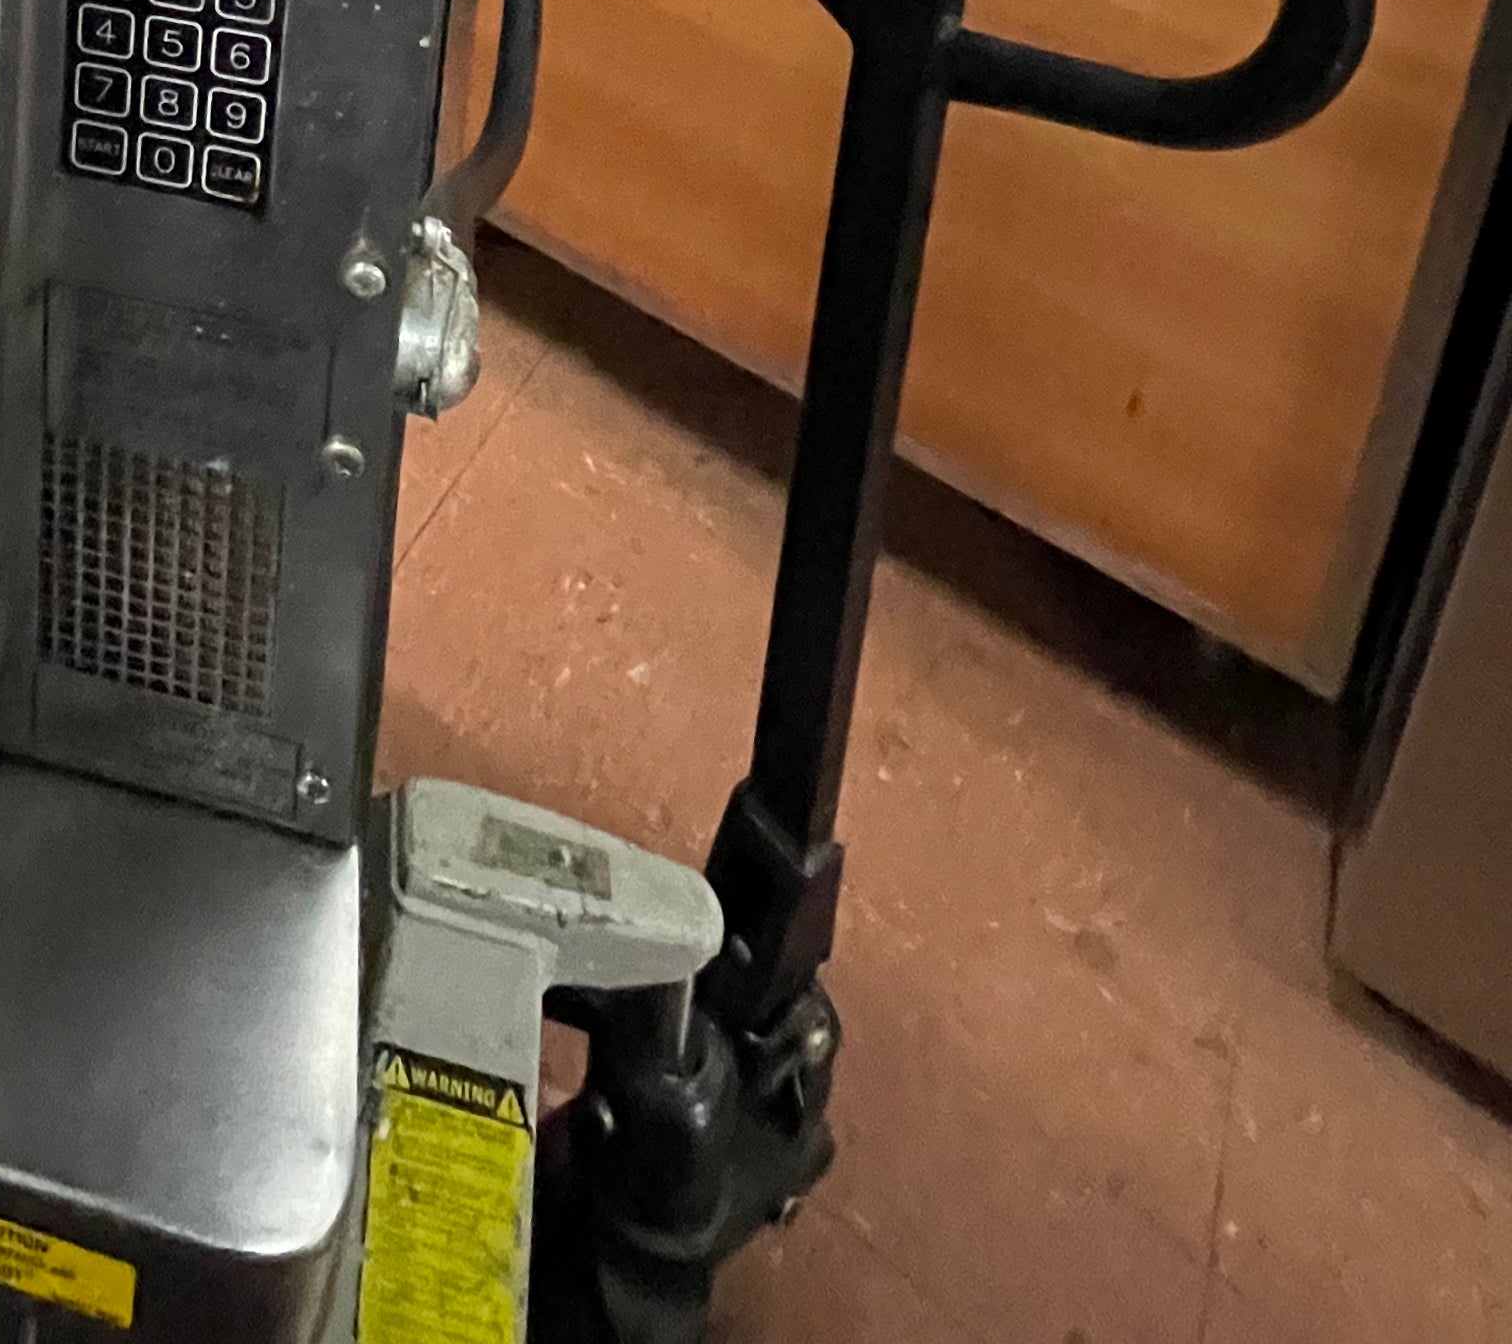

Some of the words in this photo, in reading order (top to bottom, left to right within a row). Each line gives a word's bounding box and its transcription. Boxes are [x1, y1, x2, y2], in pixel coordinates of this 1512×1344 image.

[96, 19, 116, 44] 4
[161, 29, 184, 57] 5
[229, 42, 251, 70] 6
[96, 76, 114, 101] 7
[157, 88, 180, 115] 8
[225, 102, 247, 129] 9
[154, 147, 176, 173] 0
[411, 1066, 496, 1108] WARNING
